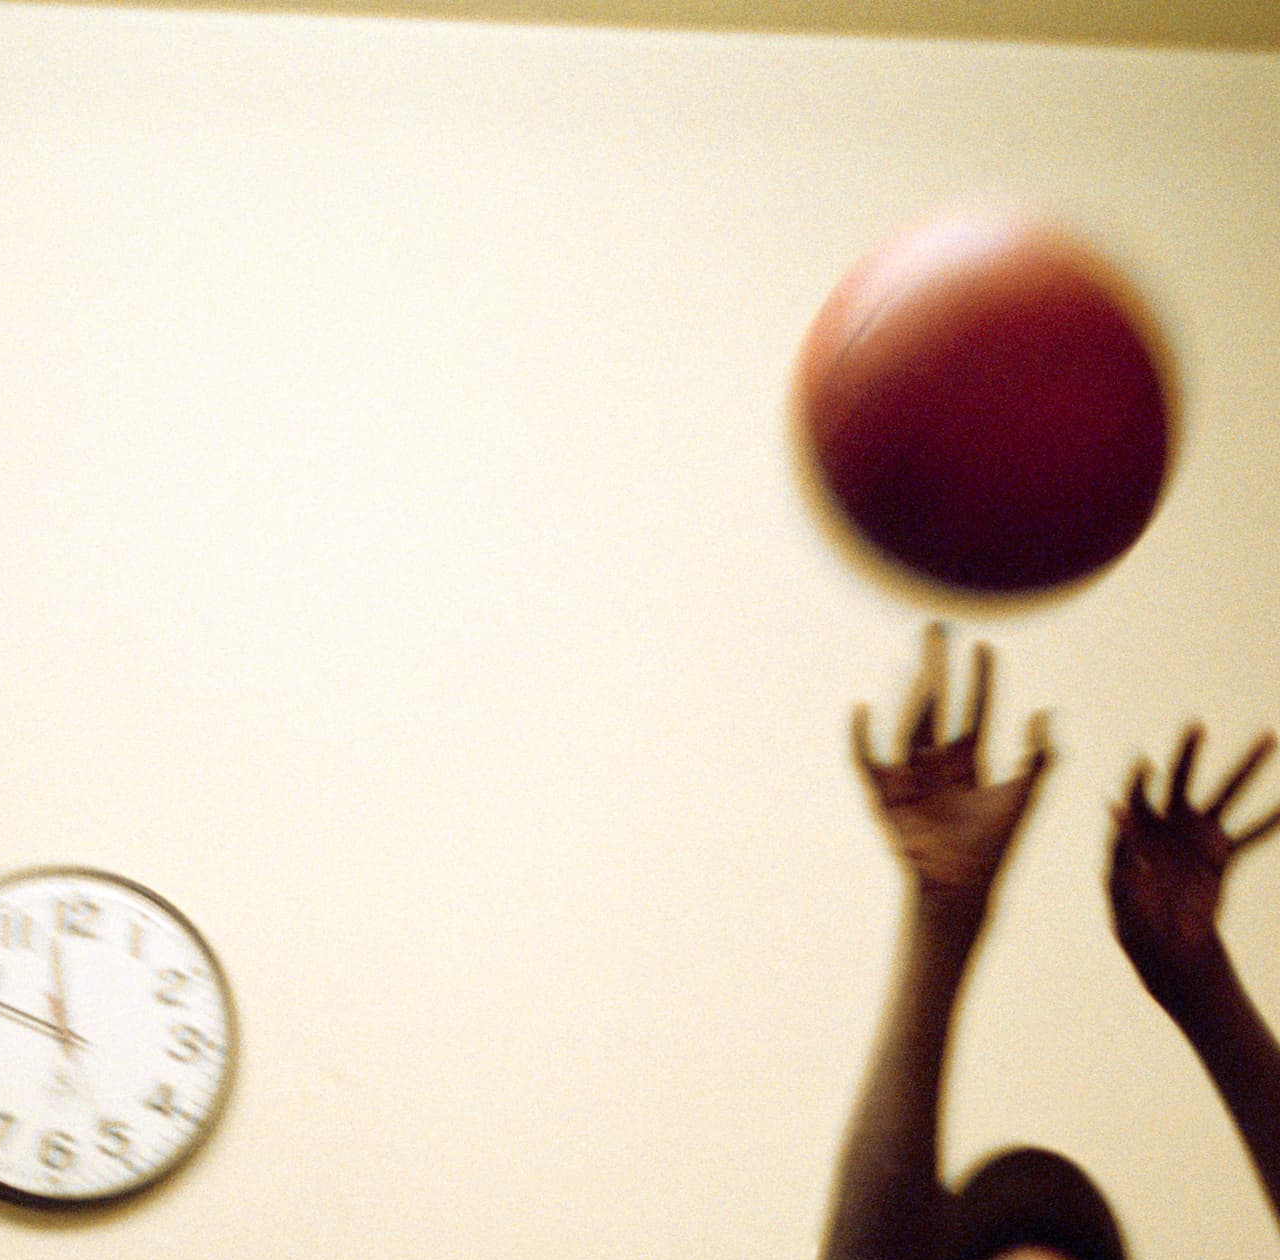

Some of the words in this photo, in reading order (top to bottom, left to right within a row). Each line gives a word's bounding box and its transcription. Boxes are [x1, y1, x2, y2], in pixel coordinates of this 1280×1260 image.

[57, 894, 101, 940] 12
[128, 921, 144, 958] 1
[156, 967, 188, 1006] 2
[169, 1024, 202, 1063] 3
[143, 1081, 183, 1121] 4
[37, 1129, 77, 1169] 6
[94, 1118, 133, 1159] 5
